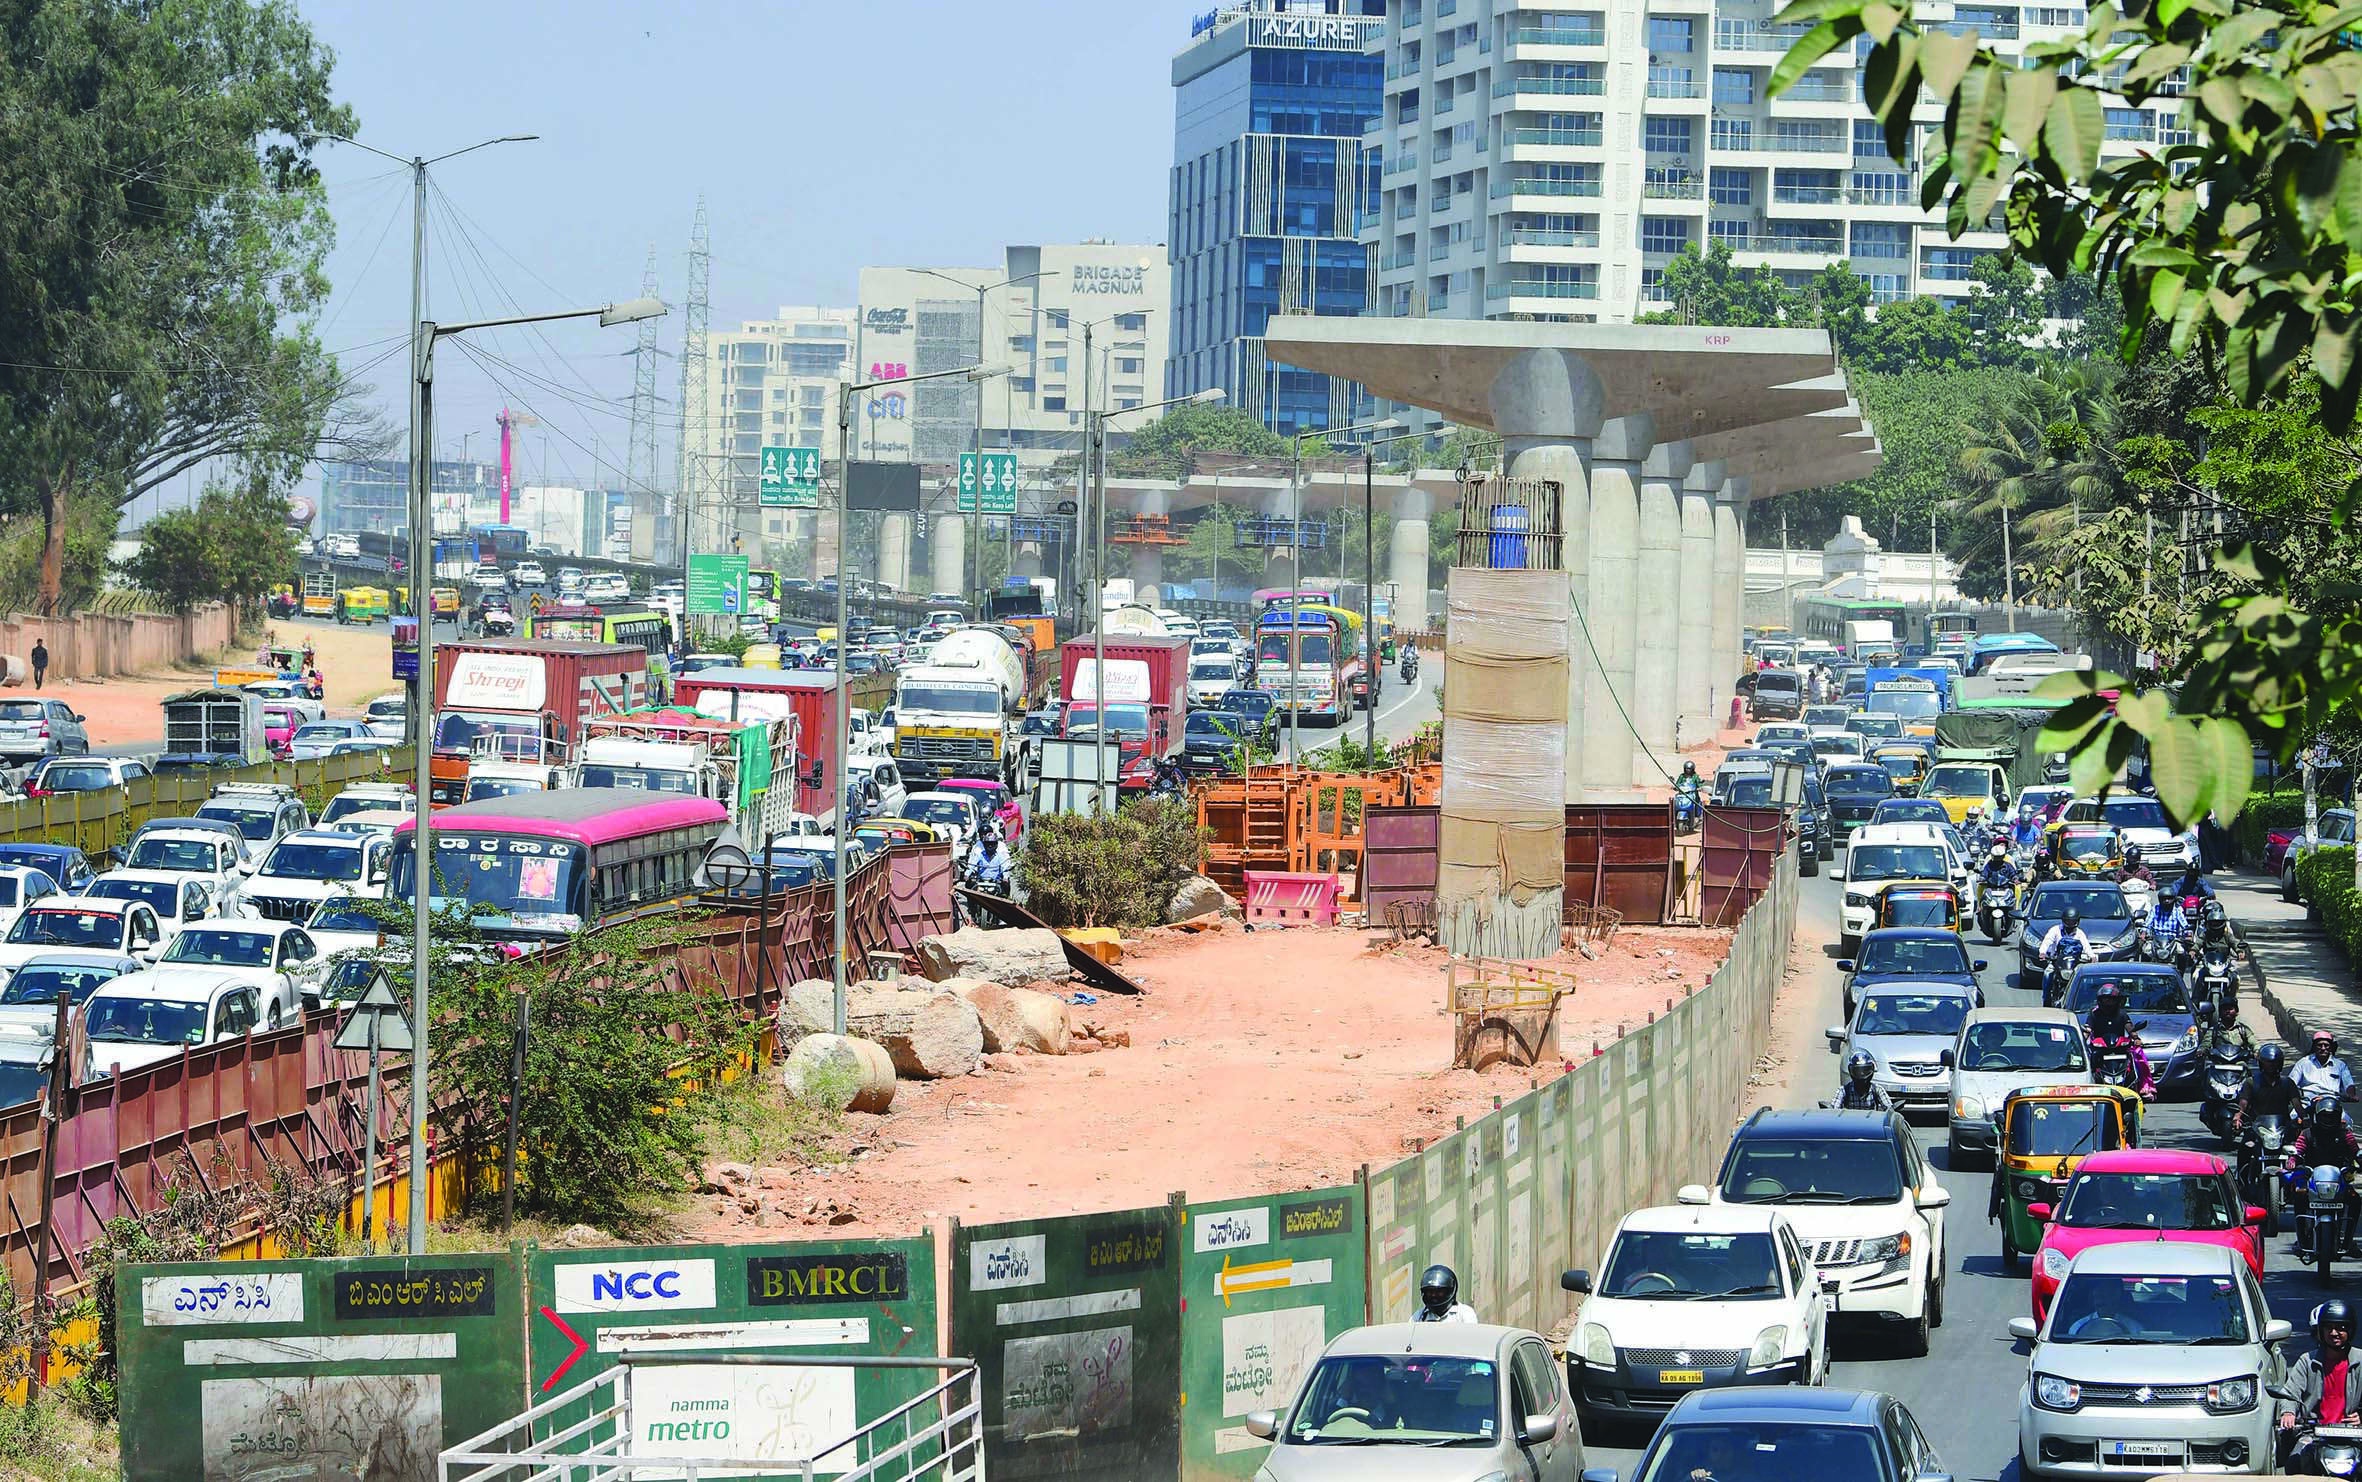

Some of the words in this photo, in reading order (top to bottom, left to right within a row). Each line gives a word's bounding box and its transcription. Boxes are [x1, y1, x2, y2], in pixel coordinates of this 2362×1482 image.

[1263, 19, 1355, 40] AZURE
[1074, 265, 1143, 280] BRIGADE
[1072, 281, 1144, 295] MAGNUM
[1706, 336, 1731, 345] KRP
[871, 363, 908, 380] ABB
[867, 394, 905, 418] citi
[593, 1270, 681, 1301] NCC
[762, 1266, 900, 1298] BMRCL
[671, 1397, 729, 1414] namma
[648, 1420, 730, 1442] metro
